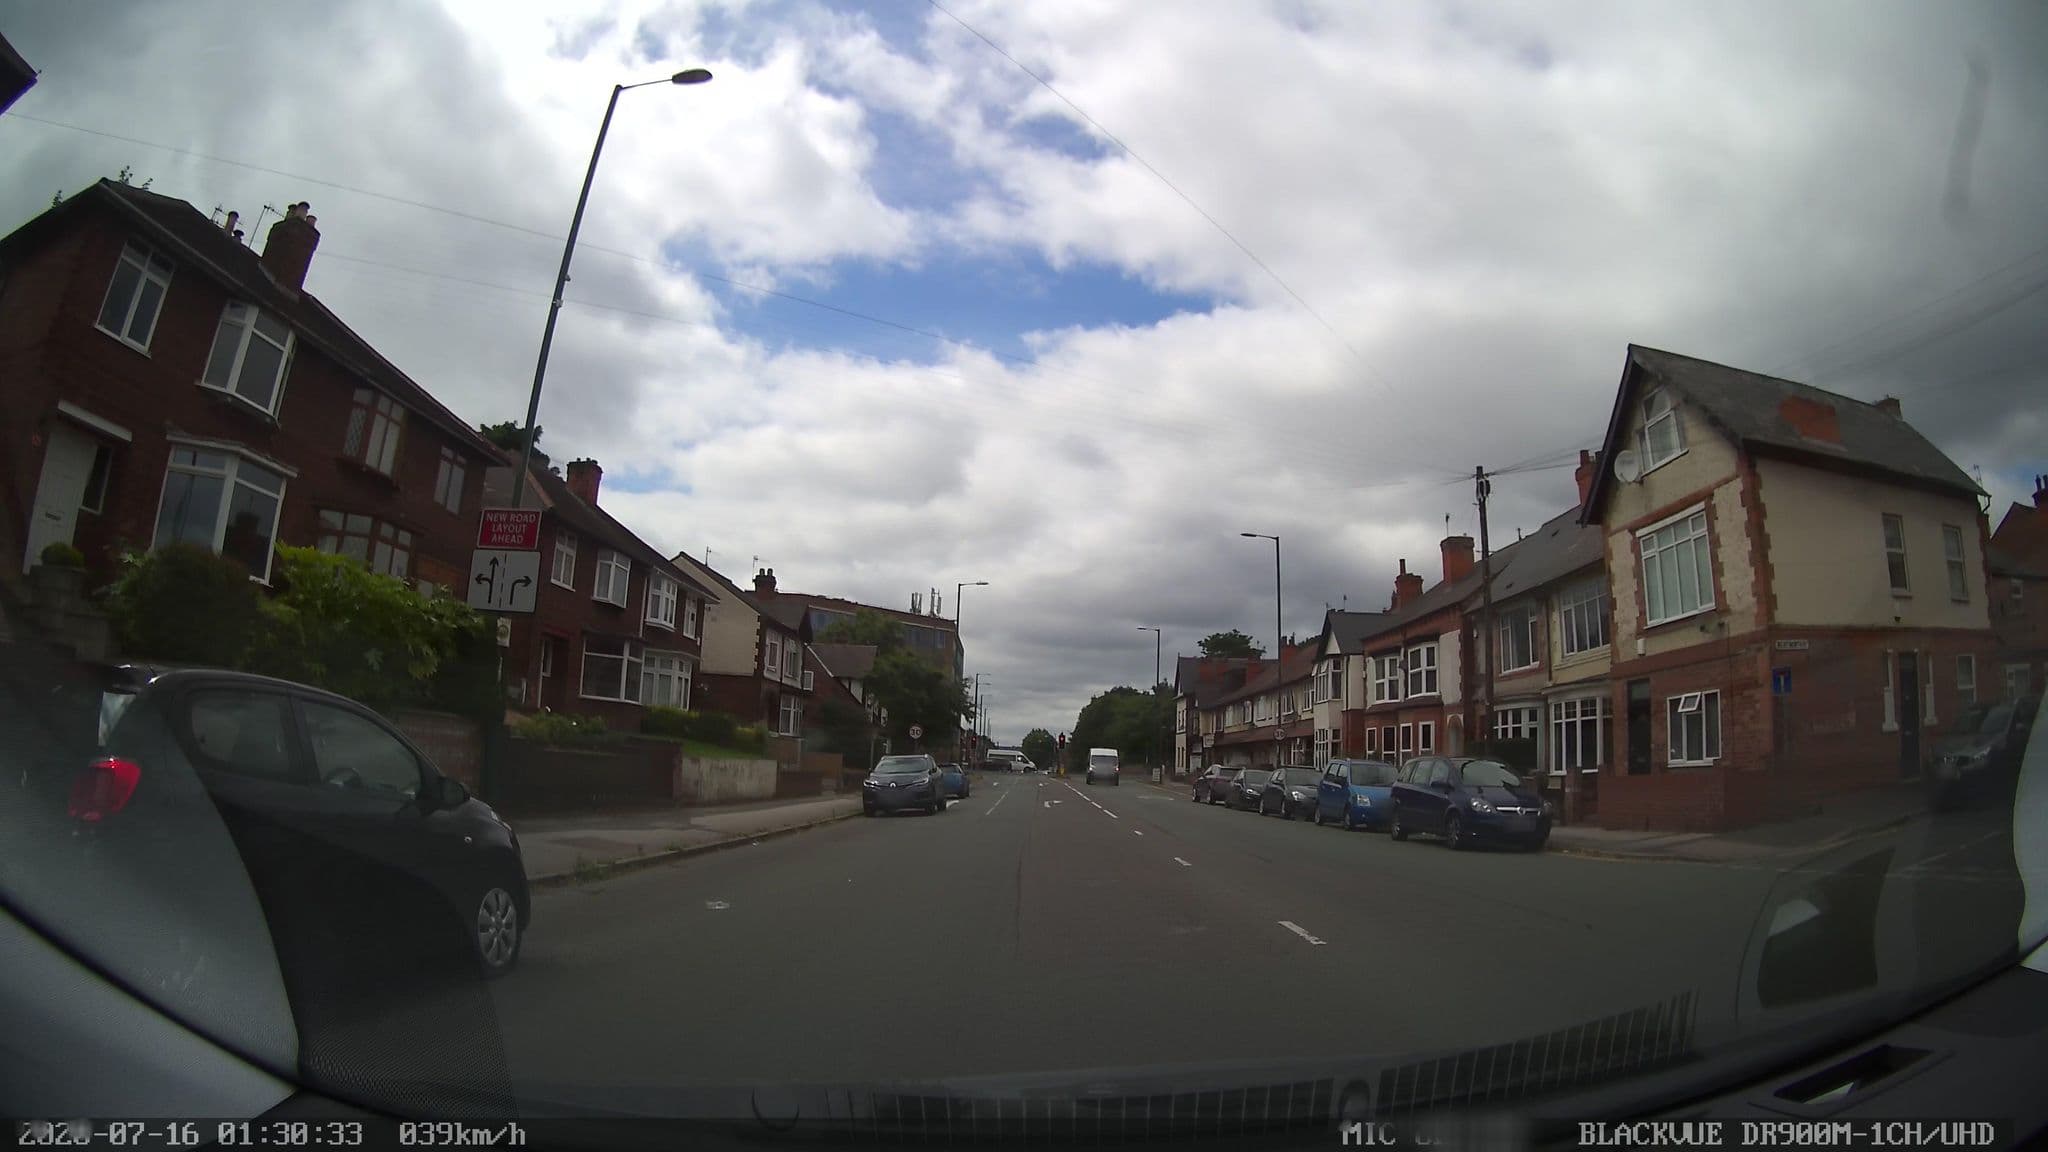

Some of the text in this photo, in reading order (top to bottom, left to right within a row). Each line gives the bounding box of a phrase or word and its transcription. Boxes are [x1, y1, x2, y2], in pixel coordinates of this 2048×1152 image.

[486, 513, 537, 523] NEW ROAD
[492, 523, 528, 533] LAYOUT
[491, 534, 524, 544] AHEAD
